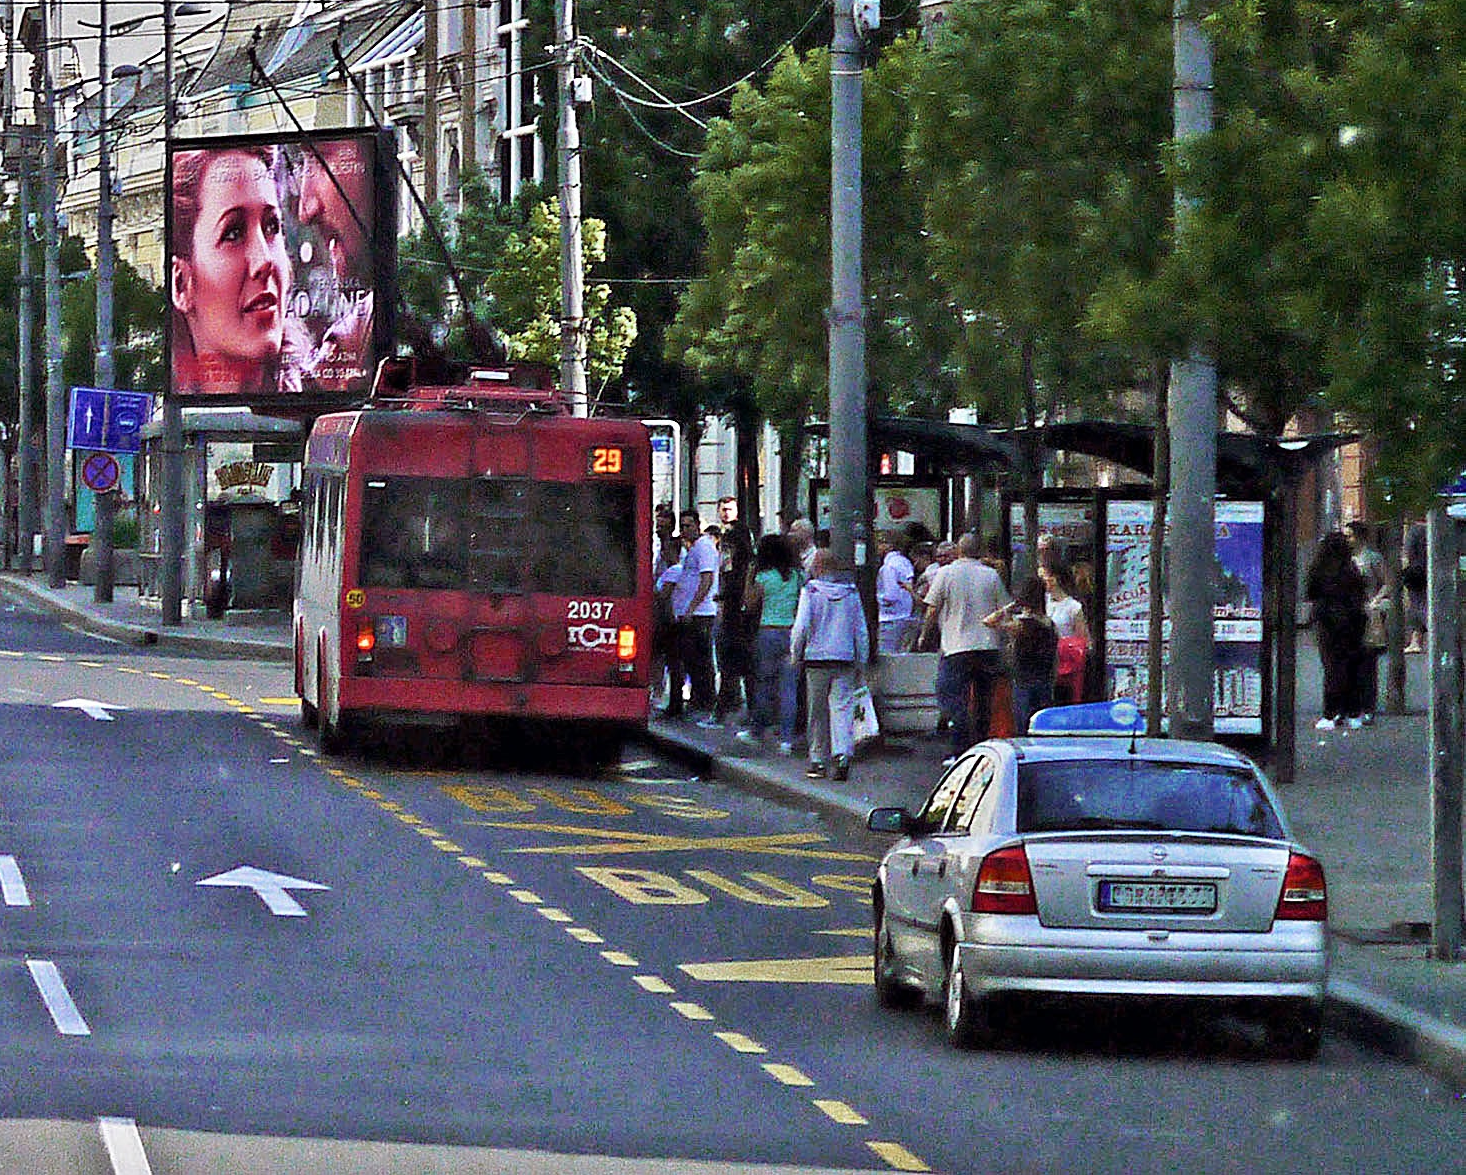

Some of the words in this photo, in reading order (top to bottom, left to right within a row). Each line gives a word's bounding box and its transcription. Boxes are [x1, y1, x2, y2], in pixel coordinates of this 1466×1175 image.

[593, 449, 622, 473] 29
[567, 601, 614, 620] 2037
[441, 785, 731, 819] BUS
